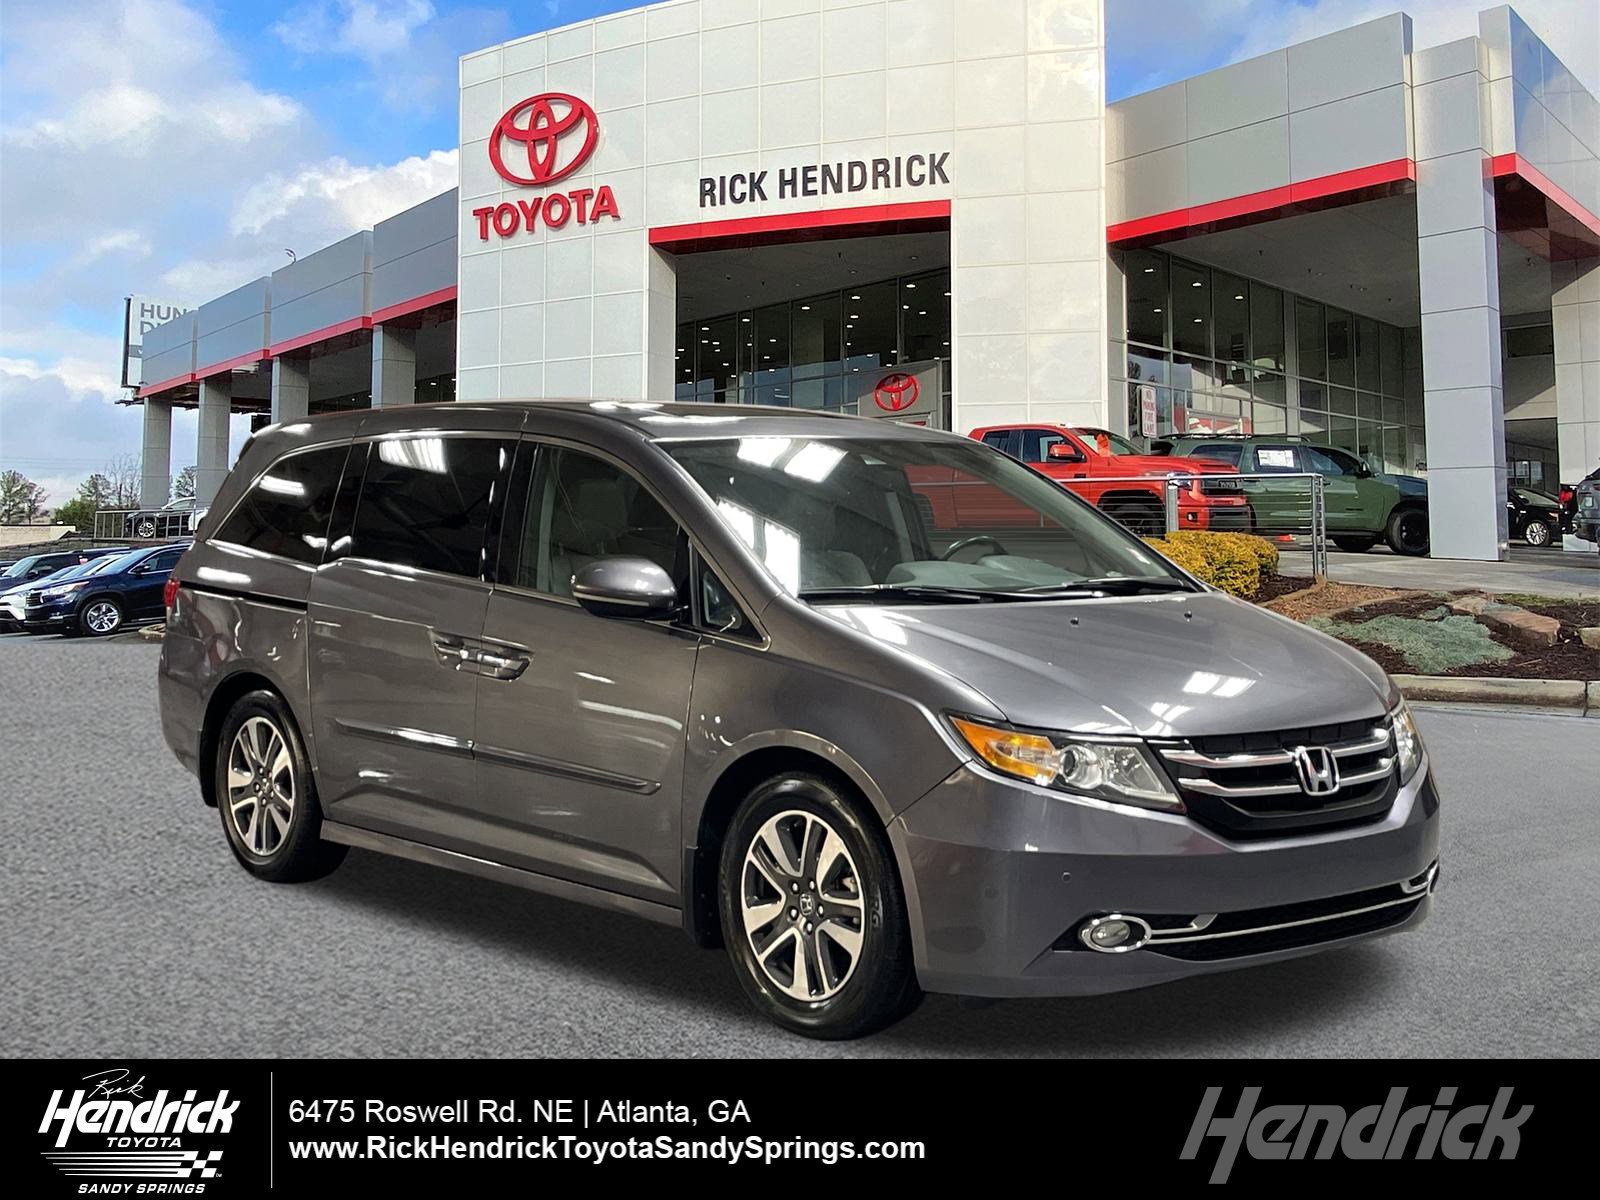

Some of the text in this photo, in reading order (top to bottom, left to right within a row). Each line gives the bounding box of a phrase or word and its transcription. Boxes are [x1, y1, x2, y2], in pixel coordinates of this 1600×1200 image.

[699, 152, 951, 207] RICK HENDRICK
[473, 186, 620, 241] TOYOTA
